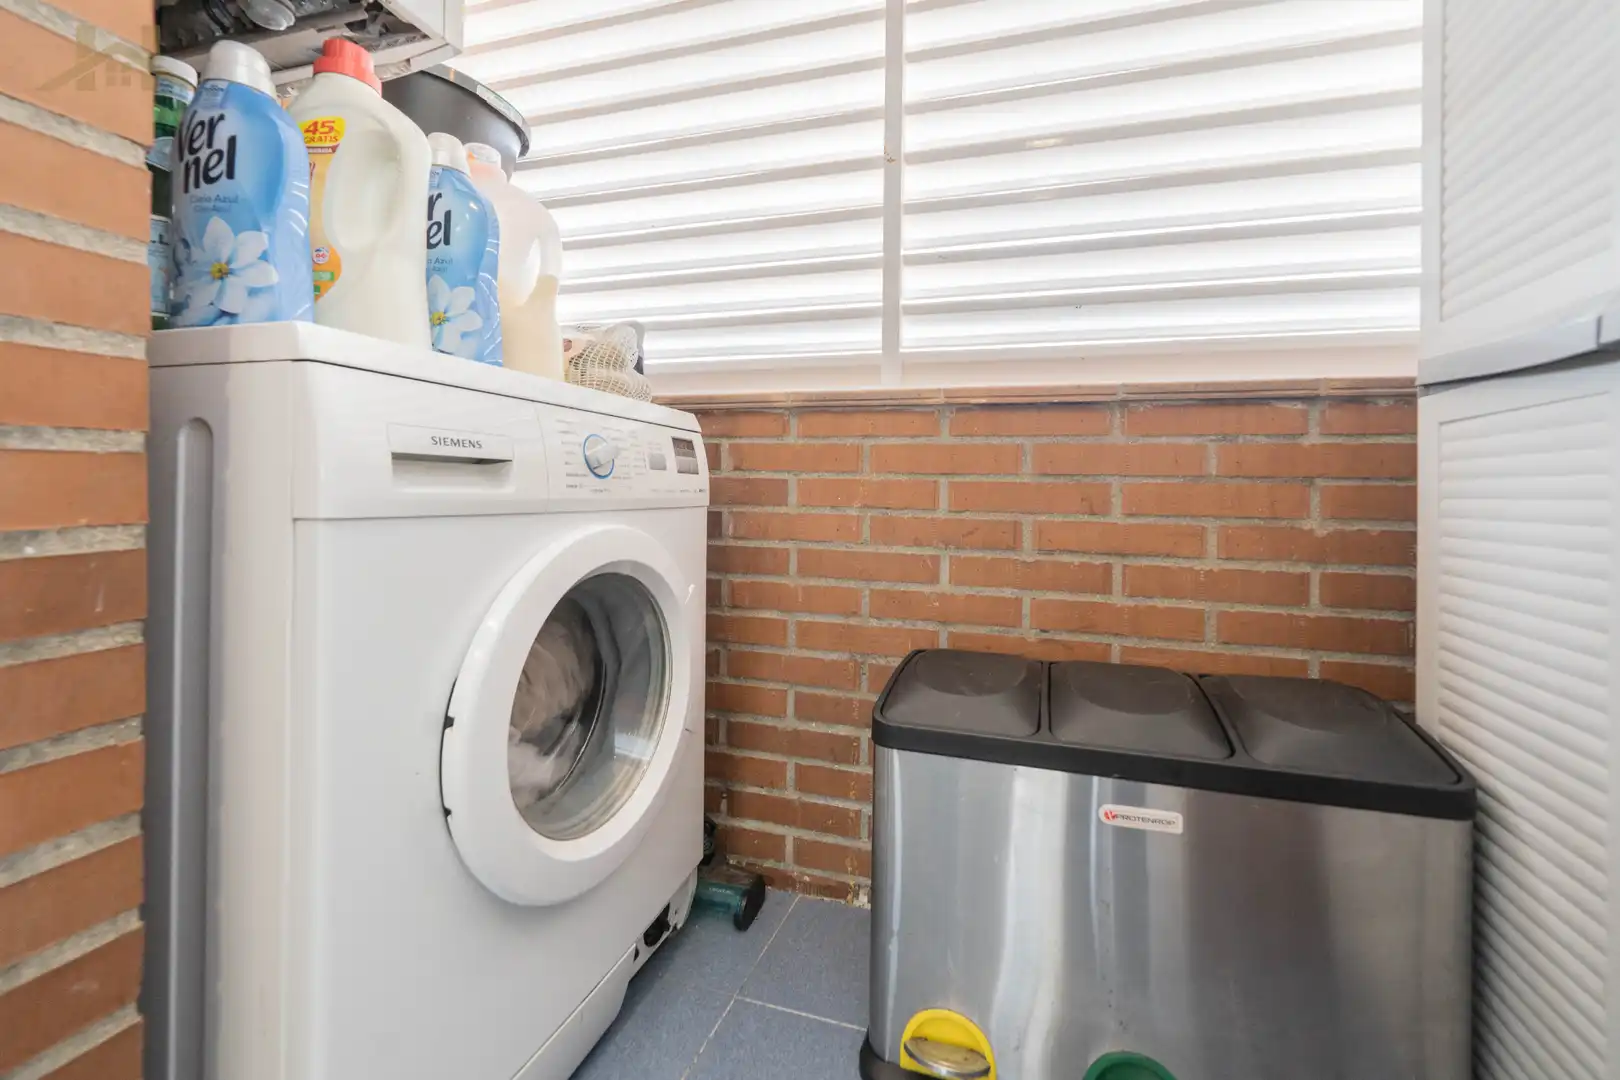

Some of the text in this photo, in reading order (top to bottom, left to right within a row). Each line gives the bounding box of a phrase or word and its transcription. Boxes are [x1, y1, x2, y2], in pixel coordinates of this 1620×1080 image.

[178, 110, 225, 163] Ver
[304, 120, 335, 135] 45
[304, 135, 339, 144] GRATIS
[183, 134, 237, 194] nel
[427, 209, 452, 250] el
[431, 435, 483, 449] SIEMENS
